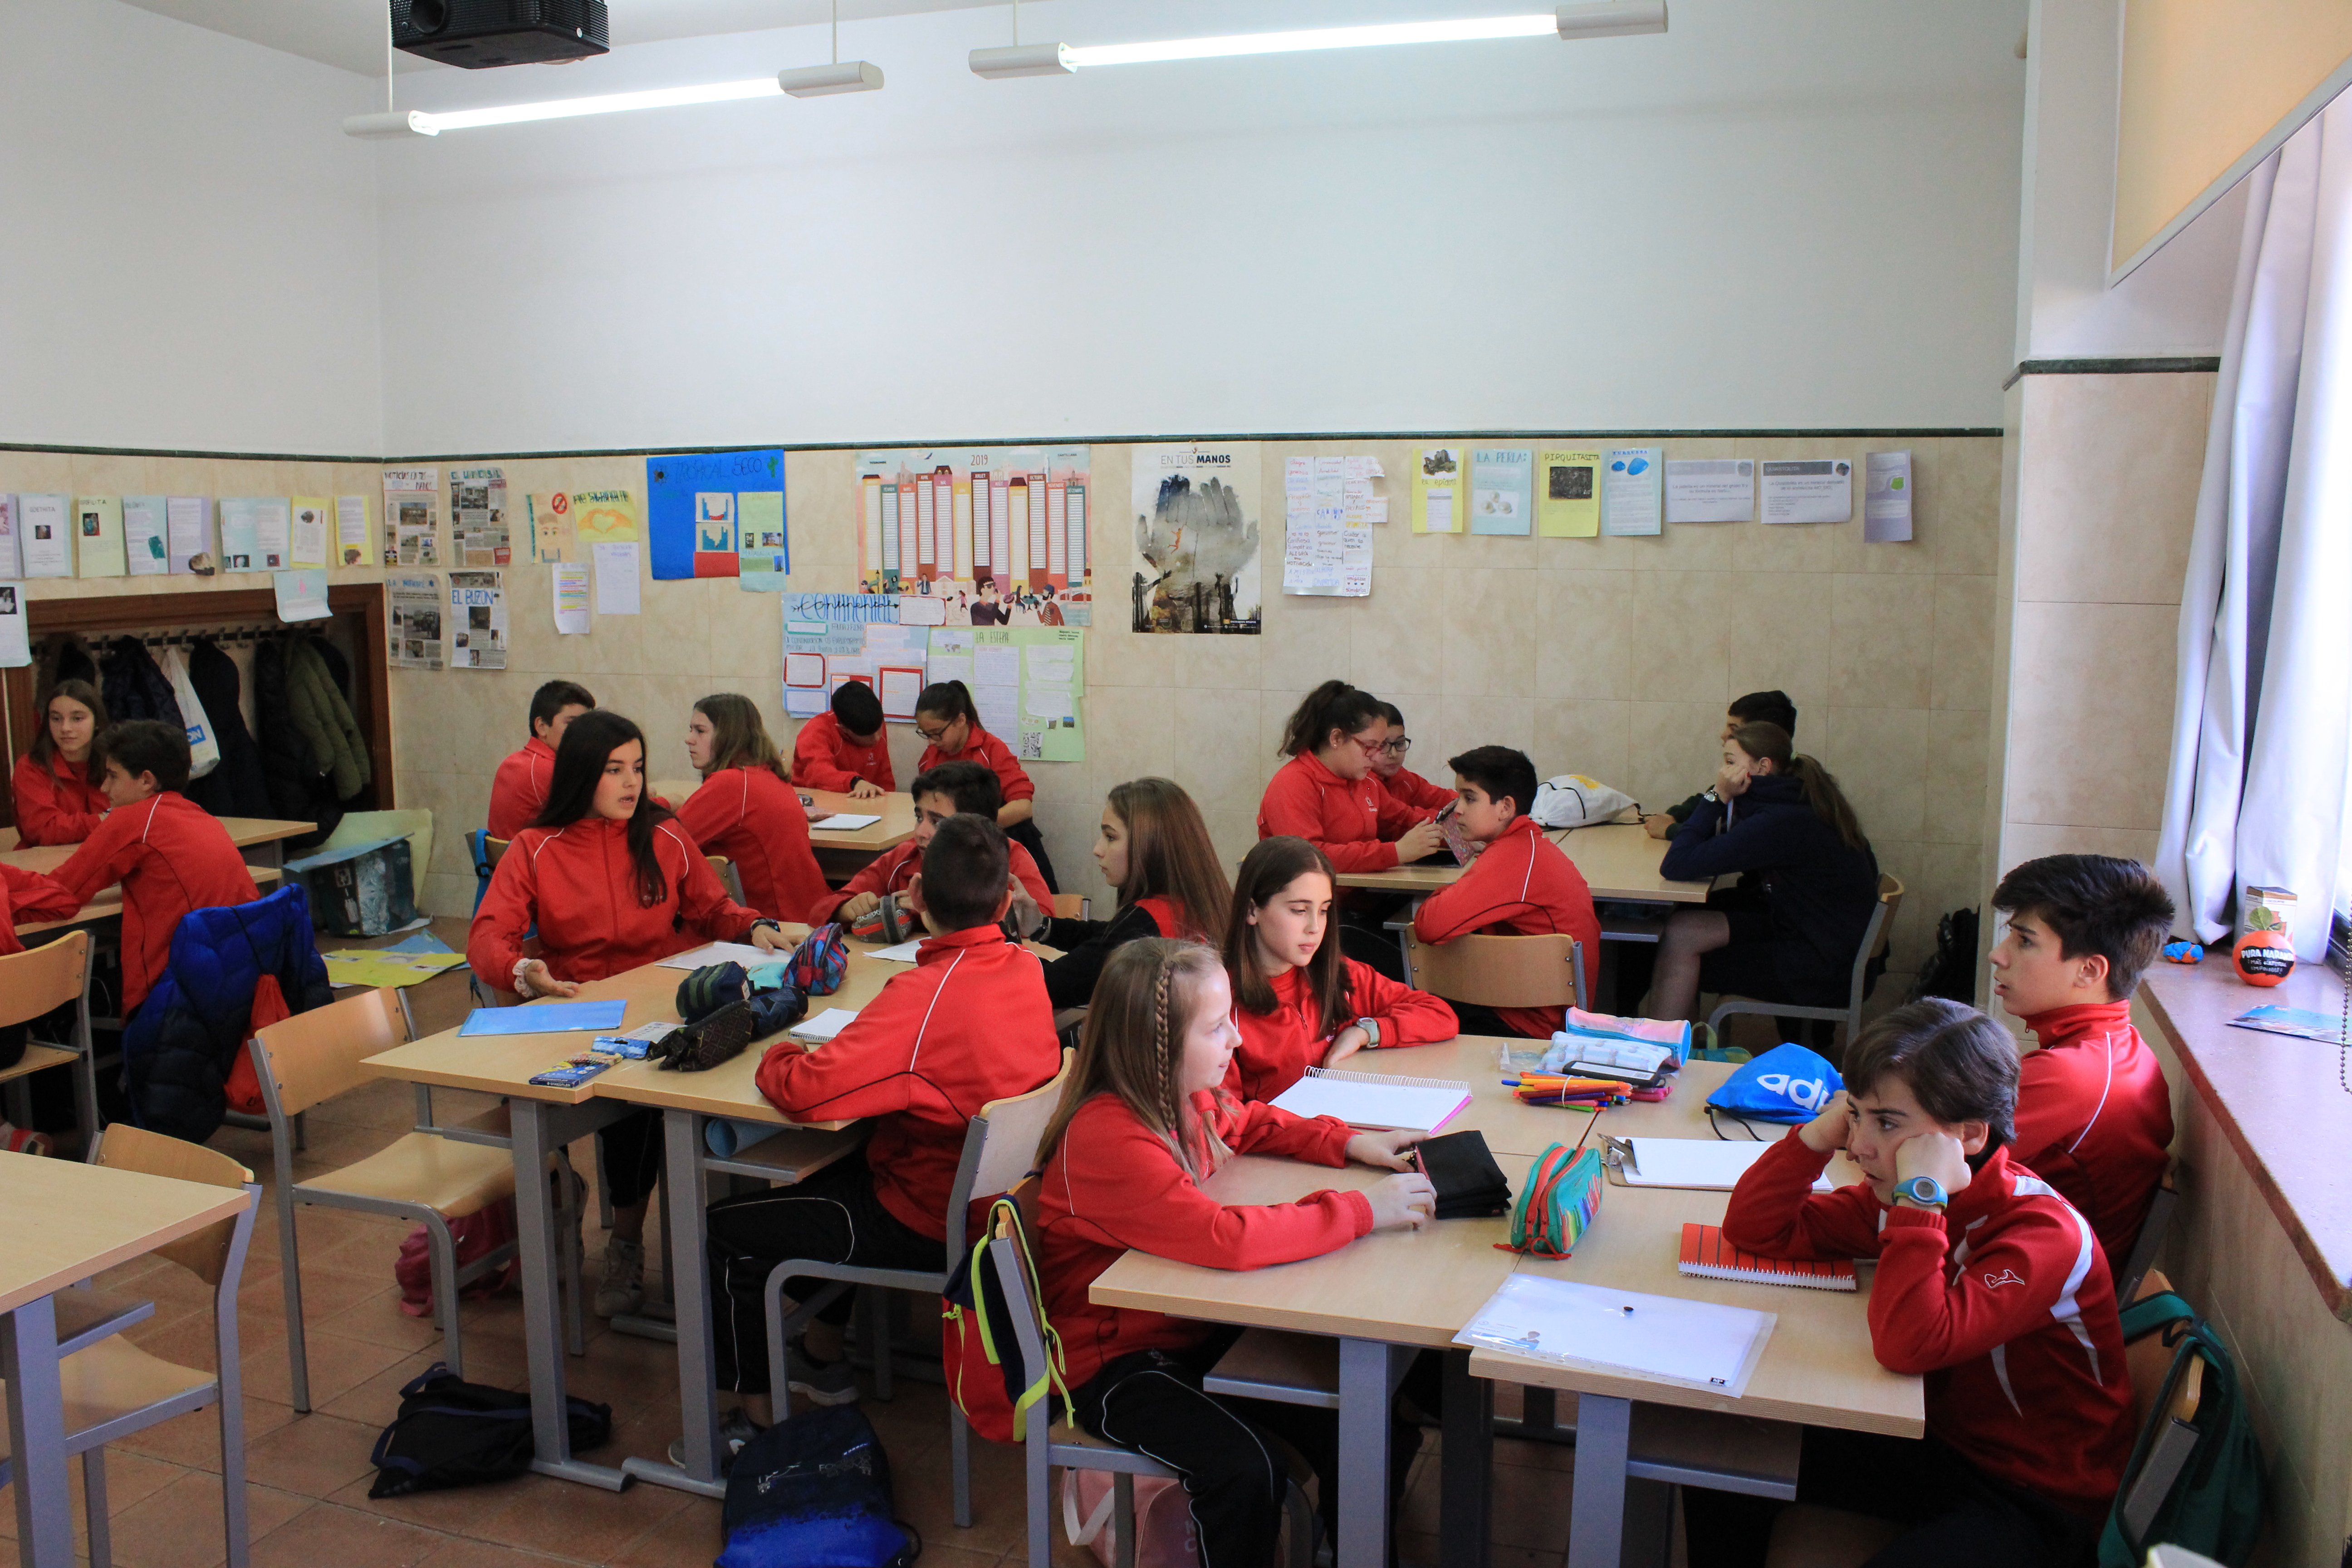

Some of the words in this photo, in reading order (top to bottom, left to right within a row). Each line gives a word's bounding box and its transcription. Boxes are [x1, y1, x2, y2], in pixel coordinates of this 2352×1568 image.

[970, 455, 988, 466] 2019
[1161, 456, 1173, 465] EN
[1175, 455, 1194, 465] TUS
[1196, 455, 1231, 464] MANOS
[1477, 453, 1490, 463] LA
[1545, 453, 1600, 463] PIRQUITASITA
[732, 456, 762, 475] SECO
[452, 590, 462, 604] EL
[976, 632, 984, 643] LA
[990, 632, 1009, 643] ESTEPA
[2241, 949, 2262, 959] PURA
